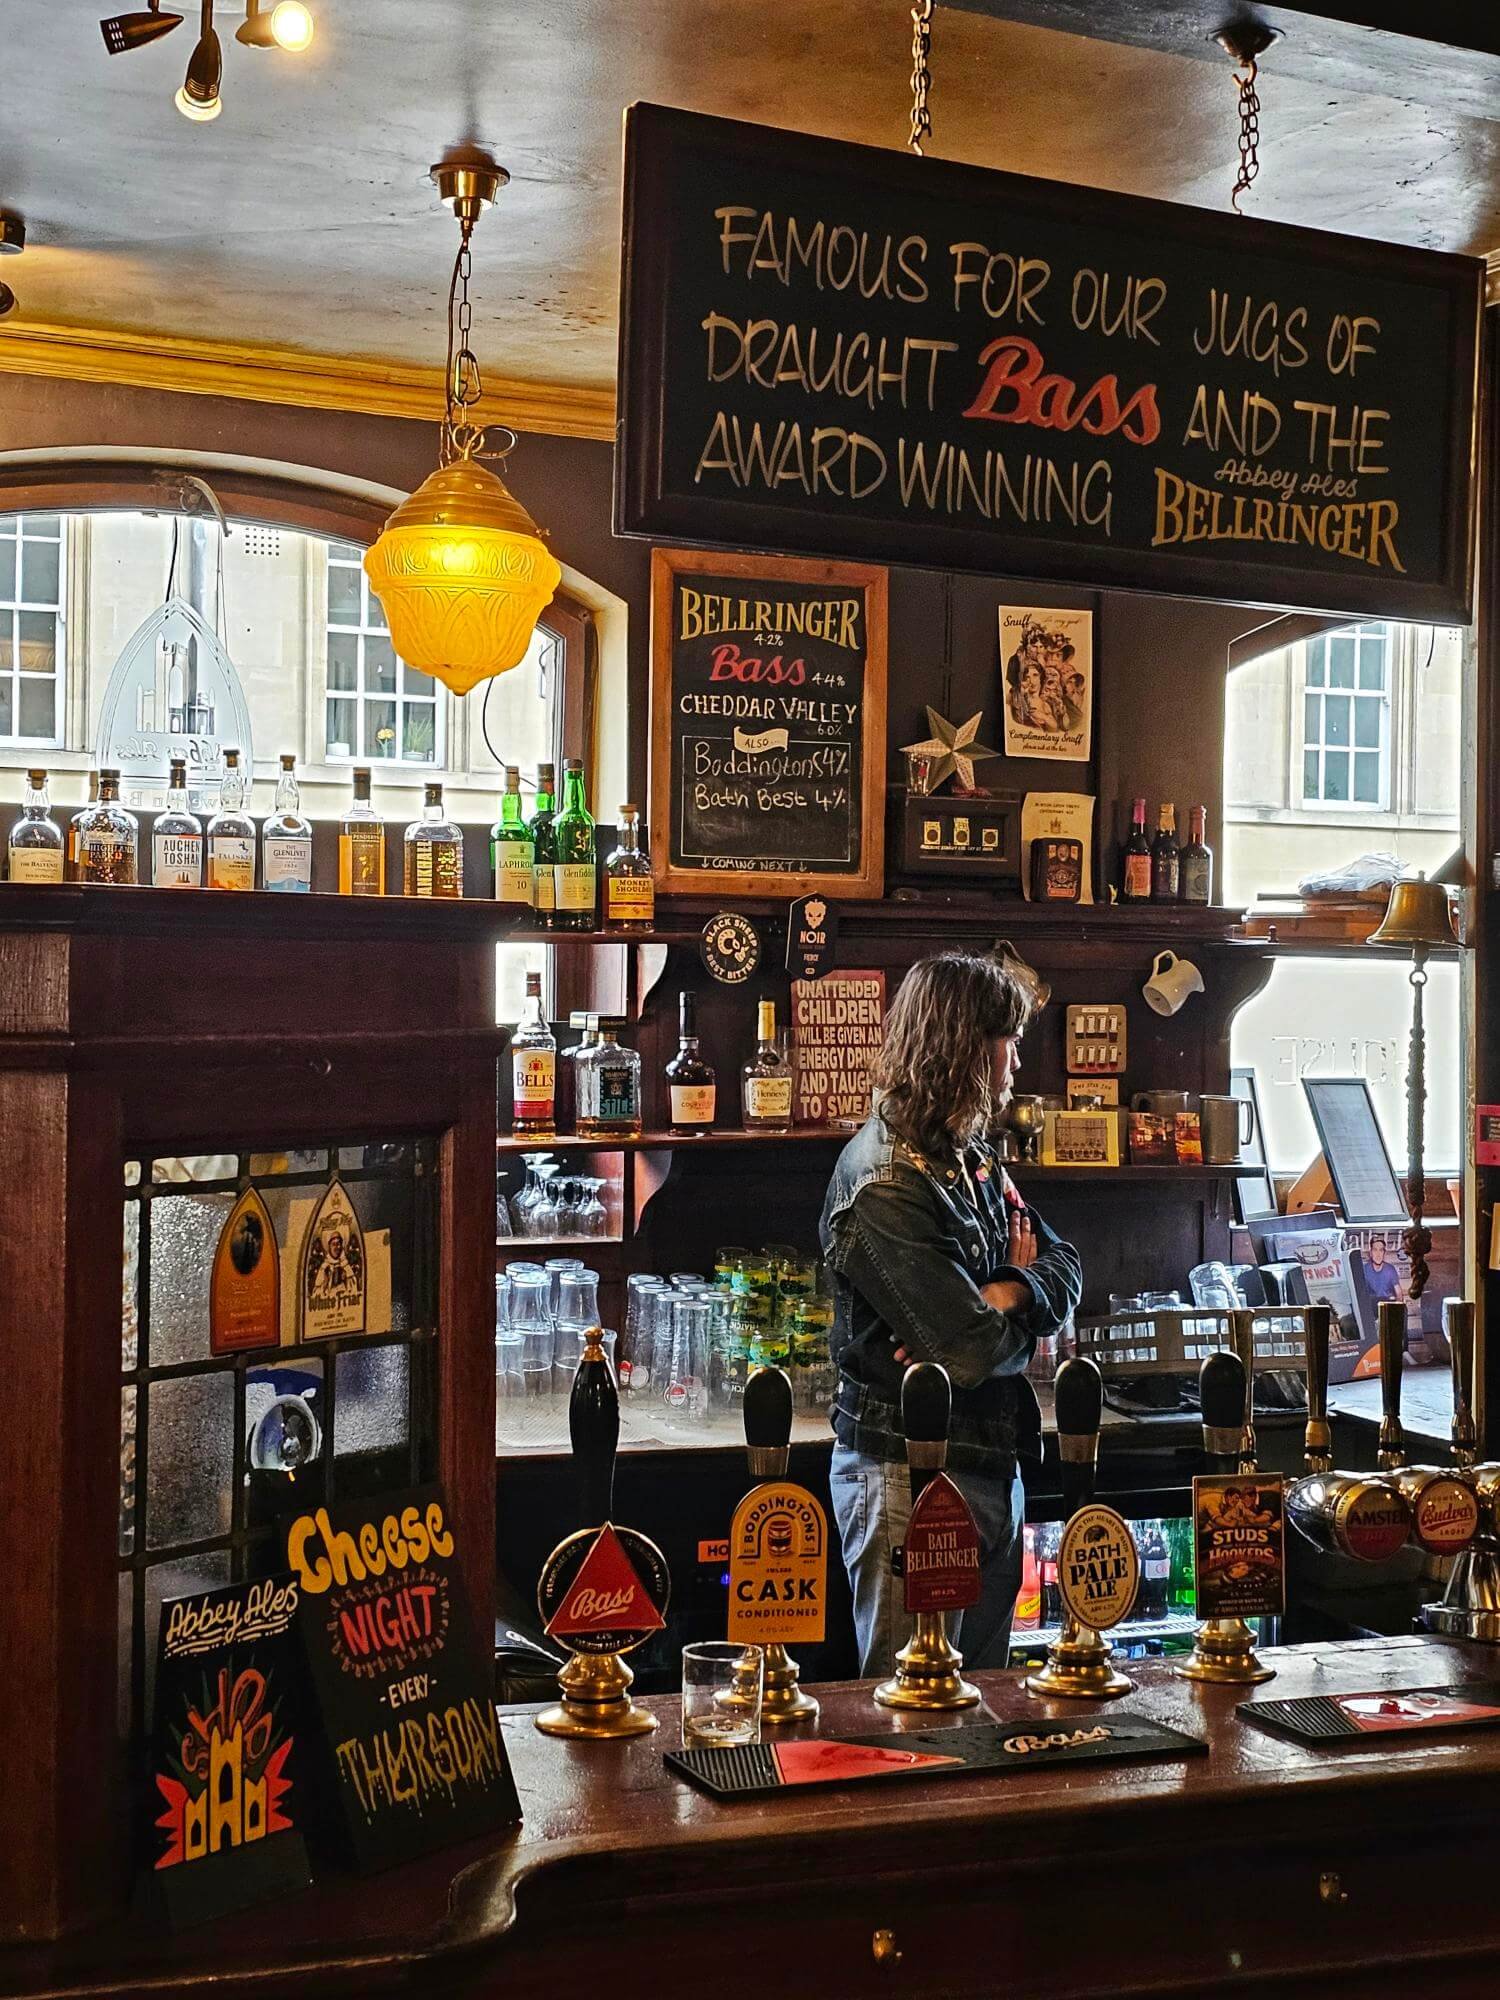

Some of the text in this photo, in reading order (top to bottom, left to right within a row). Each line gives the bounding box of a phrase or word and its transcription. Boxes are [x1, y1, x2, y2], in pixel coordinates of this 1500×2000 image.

[715, 206, 1381, 379] FAMOUS FOR OUR JUGS OF
[702, 310, 1392, 475] DRAUGHT Bass AND THE
[695, 410, 1113, 537] AWARD WINNING
[1213, 458, 1358, 499] Abbey Ales
[1151, 467, 1407, 573] BELLRINGER
[680, 587, 860, 650] BELLRINGER
[1003, 613, 1032, 628] Snuff
[709, 643, 805, 686] Bass
[680, 693, 857, 726] CHEDDAR VALLEY
[1009, 729, 1085, 746] Complimentary Snuff
[694, 741, 850, 786] Boddingtons 4%
[695, 784, 847, 812] Bath Best 4%
[89, 844, 134, 853] HIGHLAND
[90, 852, 113, 860] PARK
[163, 839, 200, 852] AUCHEN
[273, 849, 306, 857] GLENLIVET
[164, 852, 200, 865] TOSHAN
[499, 860, 534, 869] LAPHRO
[712, 856, 794, 873] COMING NEXT
[536, 867, 554, 879] Glen
[516, 880, 527, 890] 10
[706, 918, 758, 947] BLACK SHEEP
[800, 930, 826, 944] NOIR
[706, 953, 757, 980] BEST BITTER
[797, 980, 880, 999] UNATTENDED
[797, 999, 881, 1025] CHILDREN
[800, 1026, 882, 1045] WILL BE GIVEN AN
[800, 1047, 845, 1070] ENERGY
[516, 1071, 553, 1088] BELL'S
[800, 1071, 828, 1094] AND
[800, 1095, 871, 1119] TO SWEA
[308, 1294, 336, 1313] White
[744, 1496, 815, 1544] BODDINGTONS
[1421, 1502, 1474, 1527] Budvar
[288, 1503, 454, 1593] Cheese
[928, 1531, 957, 1551] BATH
[1212, 1528, 1269, 1545] STUDS
[707, 1544, 728, 1557] HO
[907, 1547, 980, 1573] BELLRINGER
[1075, 1543, 1121, 1563] BATH
[1209, 1547, 1275, 1569] HOOKERS
[1069, 1556, 1129, 1587] PALE
[736, 1578, 817, 1602] CASK
[1084, 1580, 1117, 1600] ALE
[166, 1579, 299, 1644] Abbey Ales
[570, 1585, 635, 1620] Bass
[737, 1608, 818, 1619] CONDITIONED
[340, 1585, 437, 1656] NIGHT
[336, 1698, 503, 1817] THURSDAY
